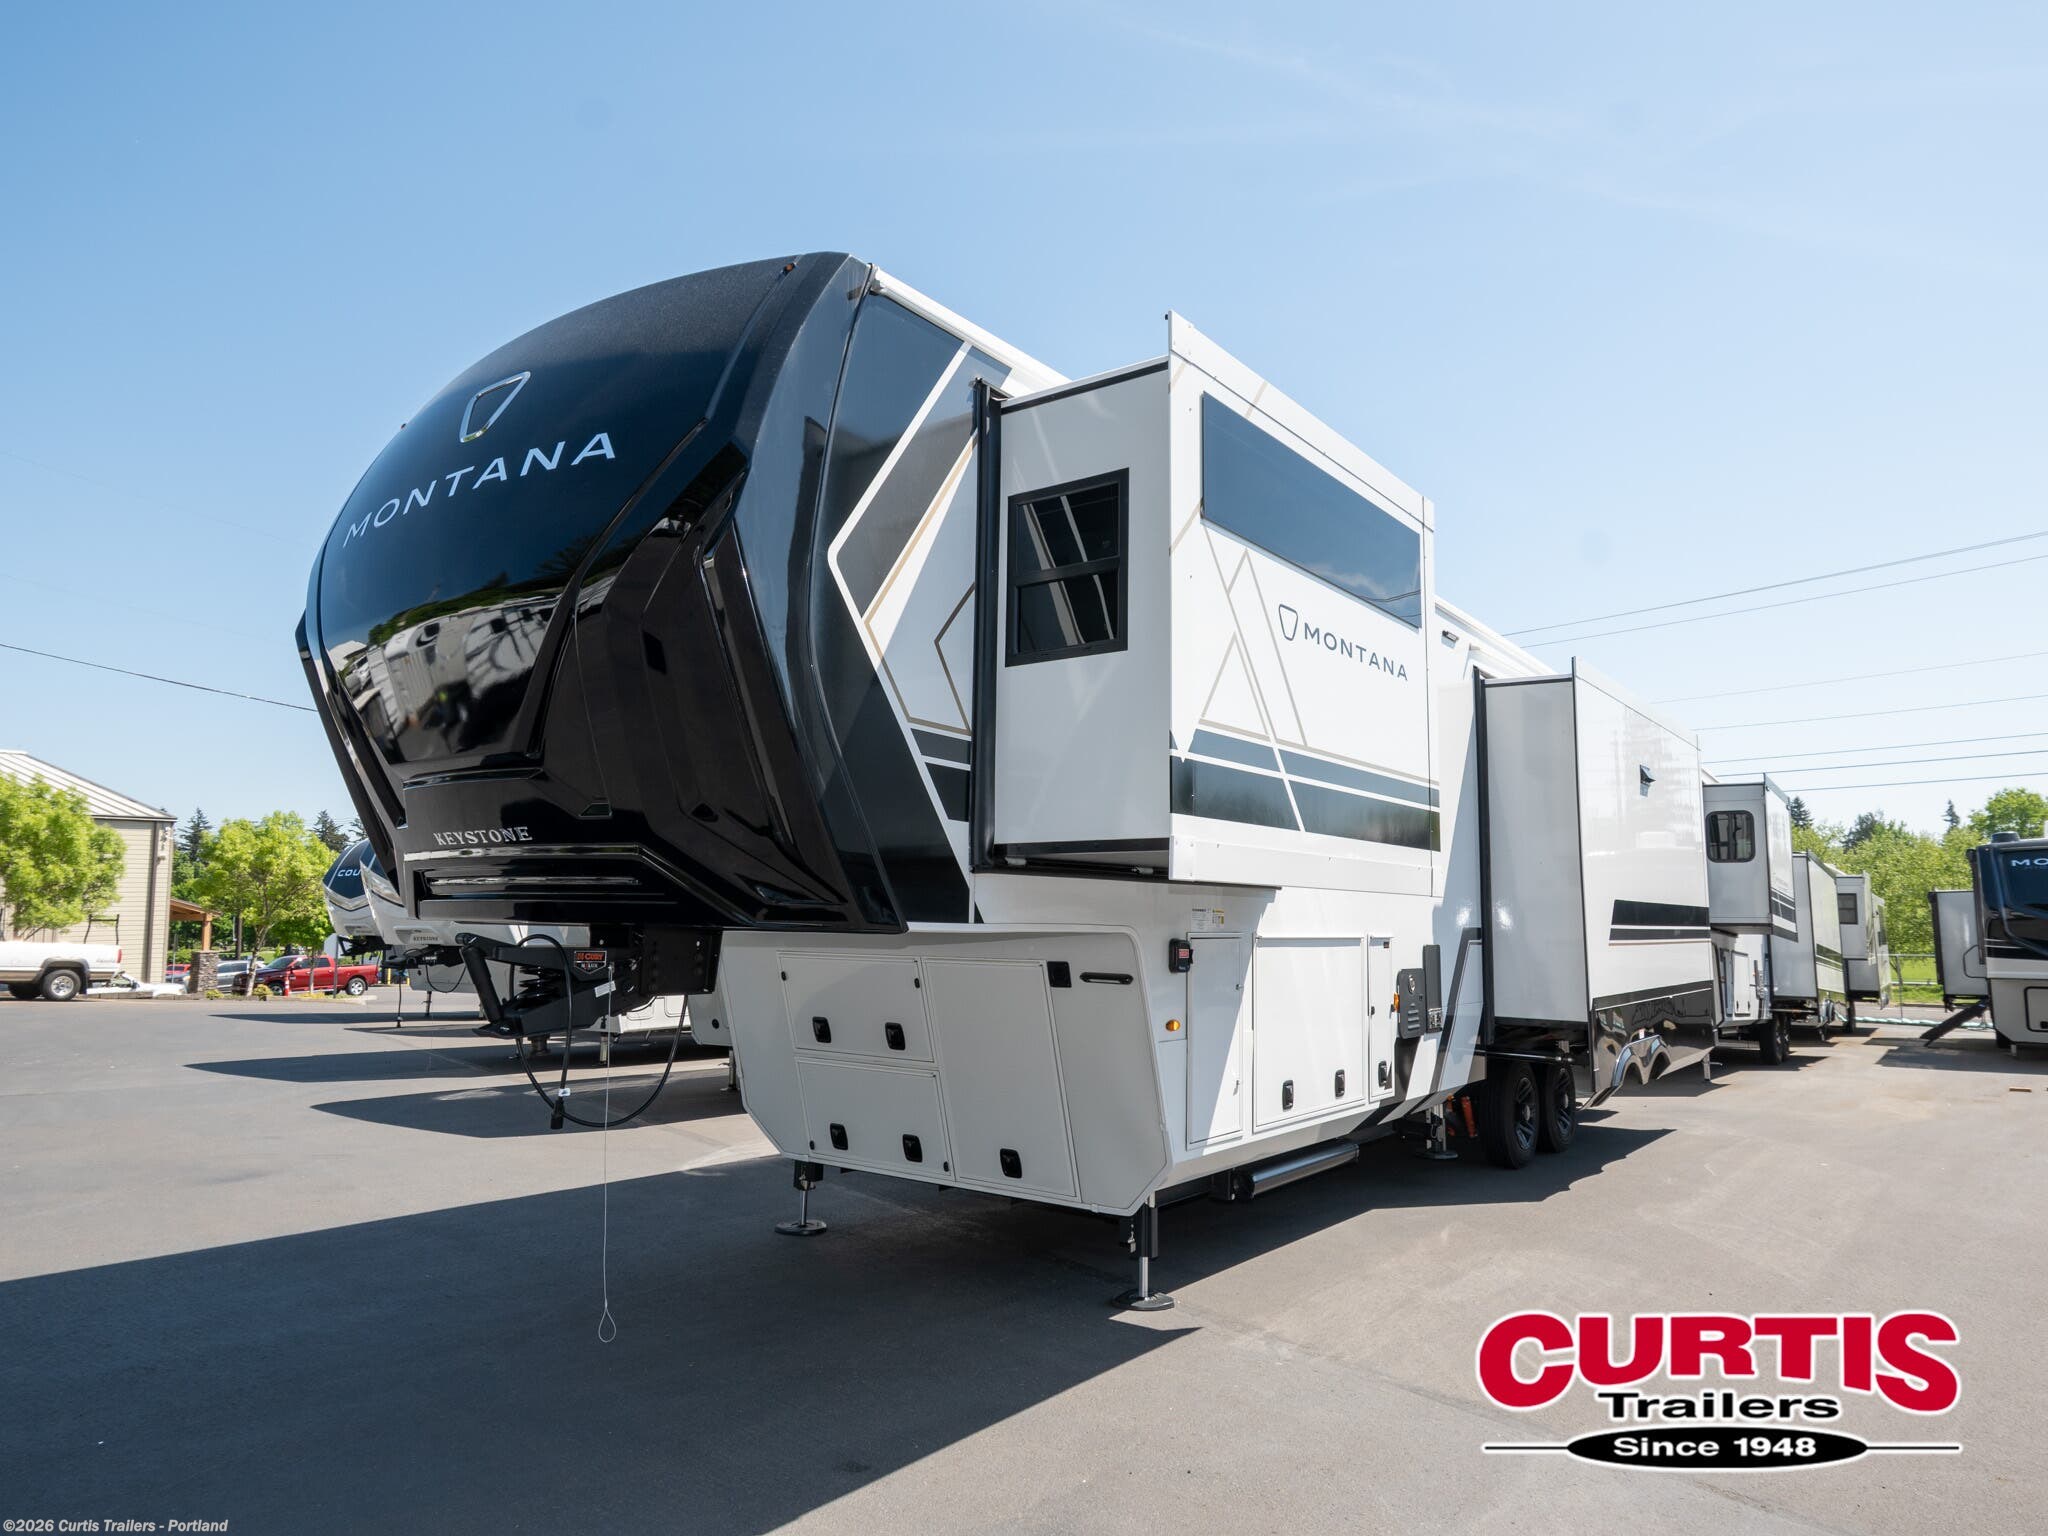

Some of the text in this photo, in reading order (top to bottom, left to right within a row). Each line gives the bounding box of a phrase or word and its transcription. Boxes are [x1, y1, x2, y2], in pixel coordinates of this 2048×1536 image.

[343, 432, 615, 548] MONTANA
[1304, 622, 1408, 681] MONTANA
[433, 826, 533, 846] KEYSTONE
